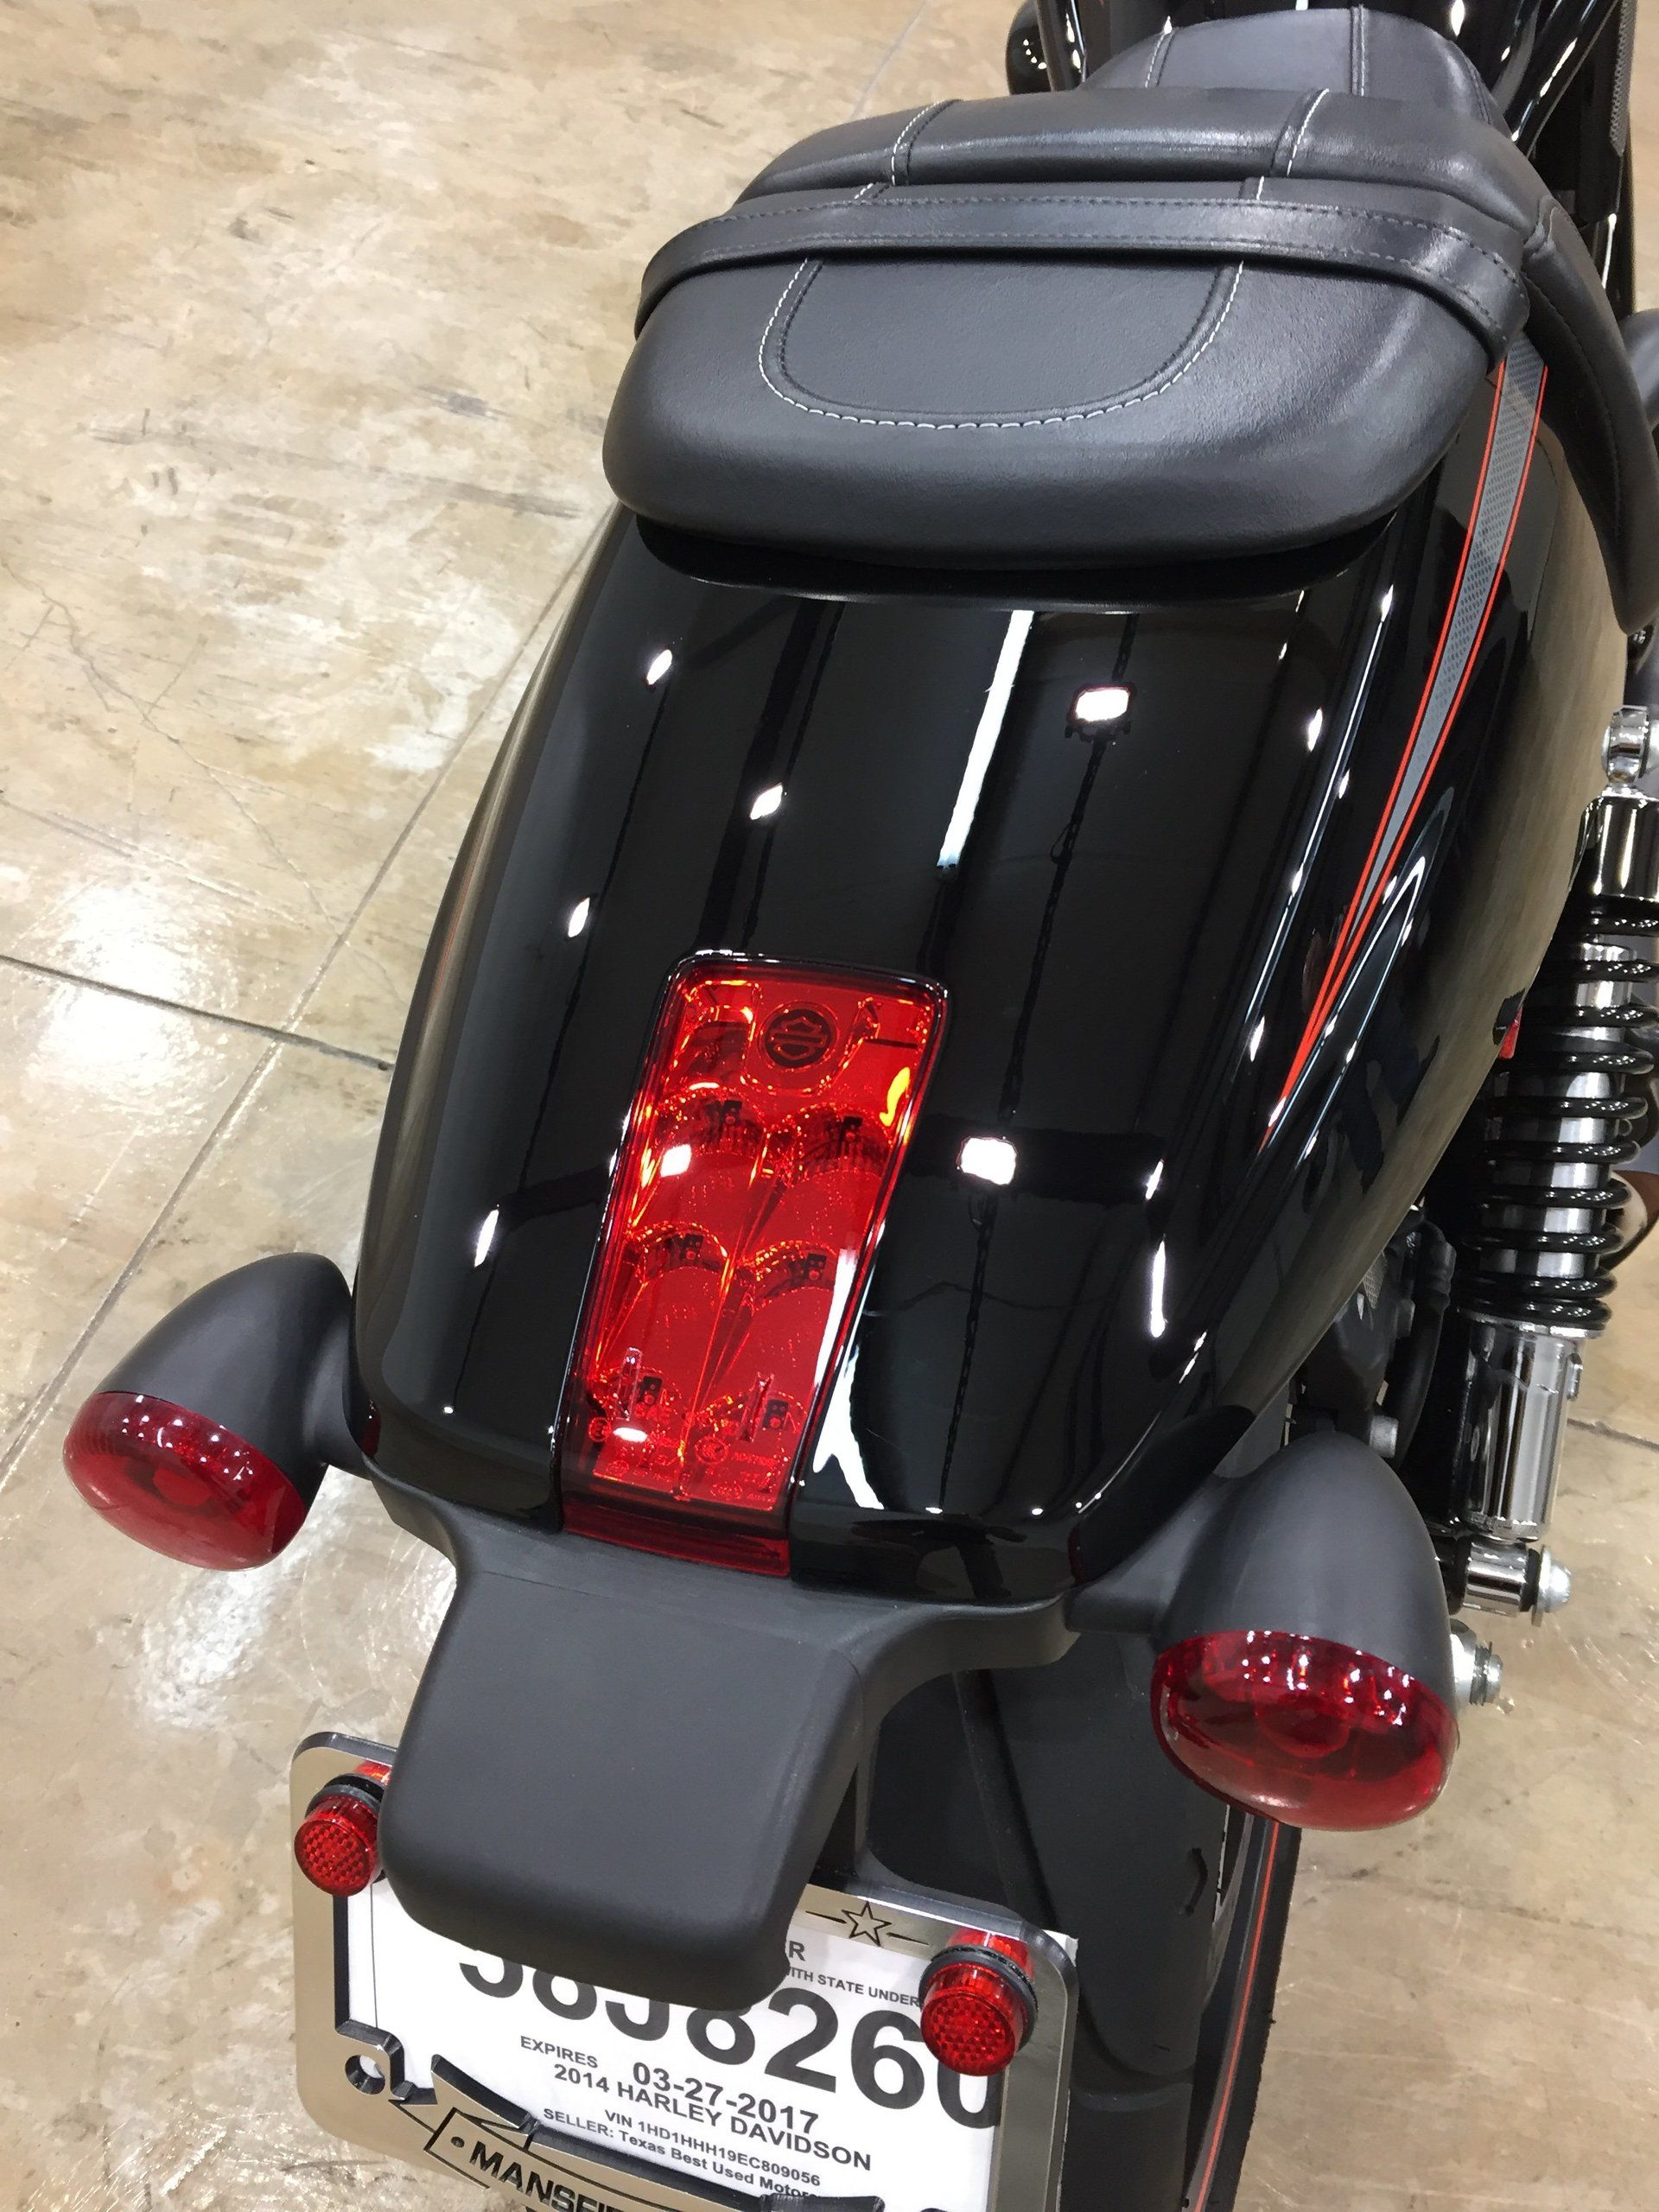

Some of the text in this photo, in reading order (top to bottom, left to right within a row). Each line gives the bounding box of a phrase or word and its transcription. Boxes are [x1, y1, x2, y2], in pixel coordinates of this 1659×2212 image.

[791, 1967, 921, 2007] ITH STATE UNDER
[521, 2036, 819, 2134] EXPIRES 03-27-2017
[554, 2063, 871, 2171] 2014 HARLEY DAVIDSON
[543, 2108, 819, 2196] SELLER: Texas Best Used Motor
[604, 2109, 821, 2186] VIN 1HD1HHH19EC809056
